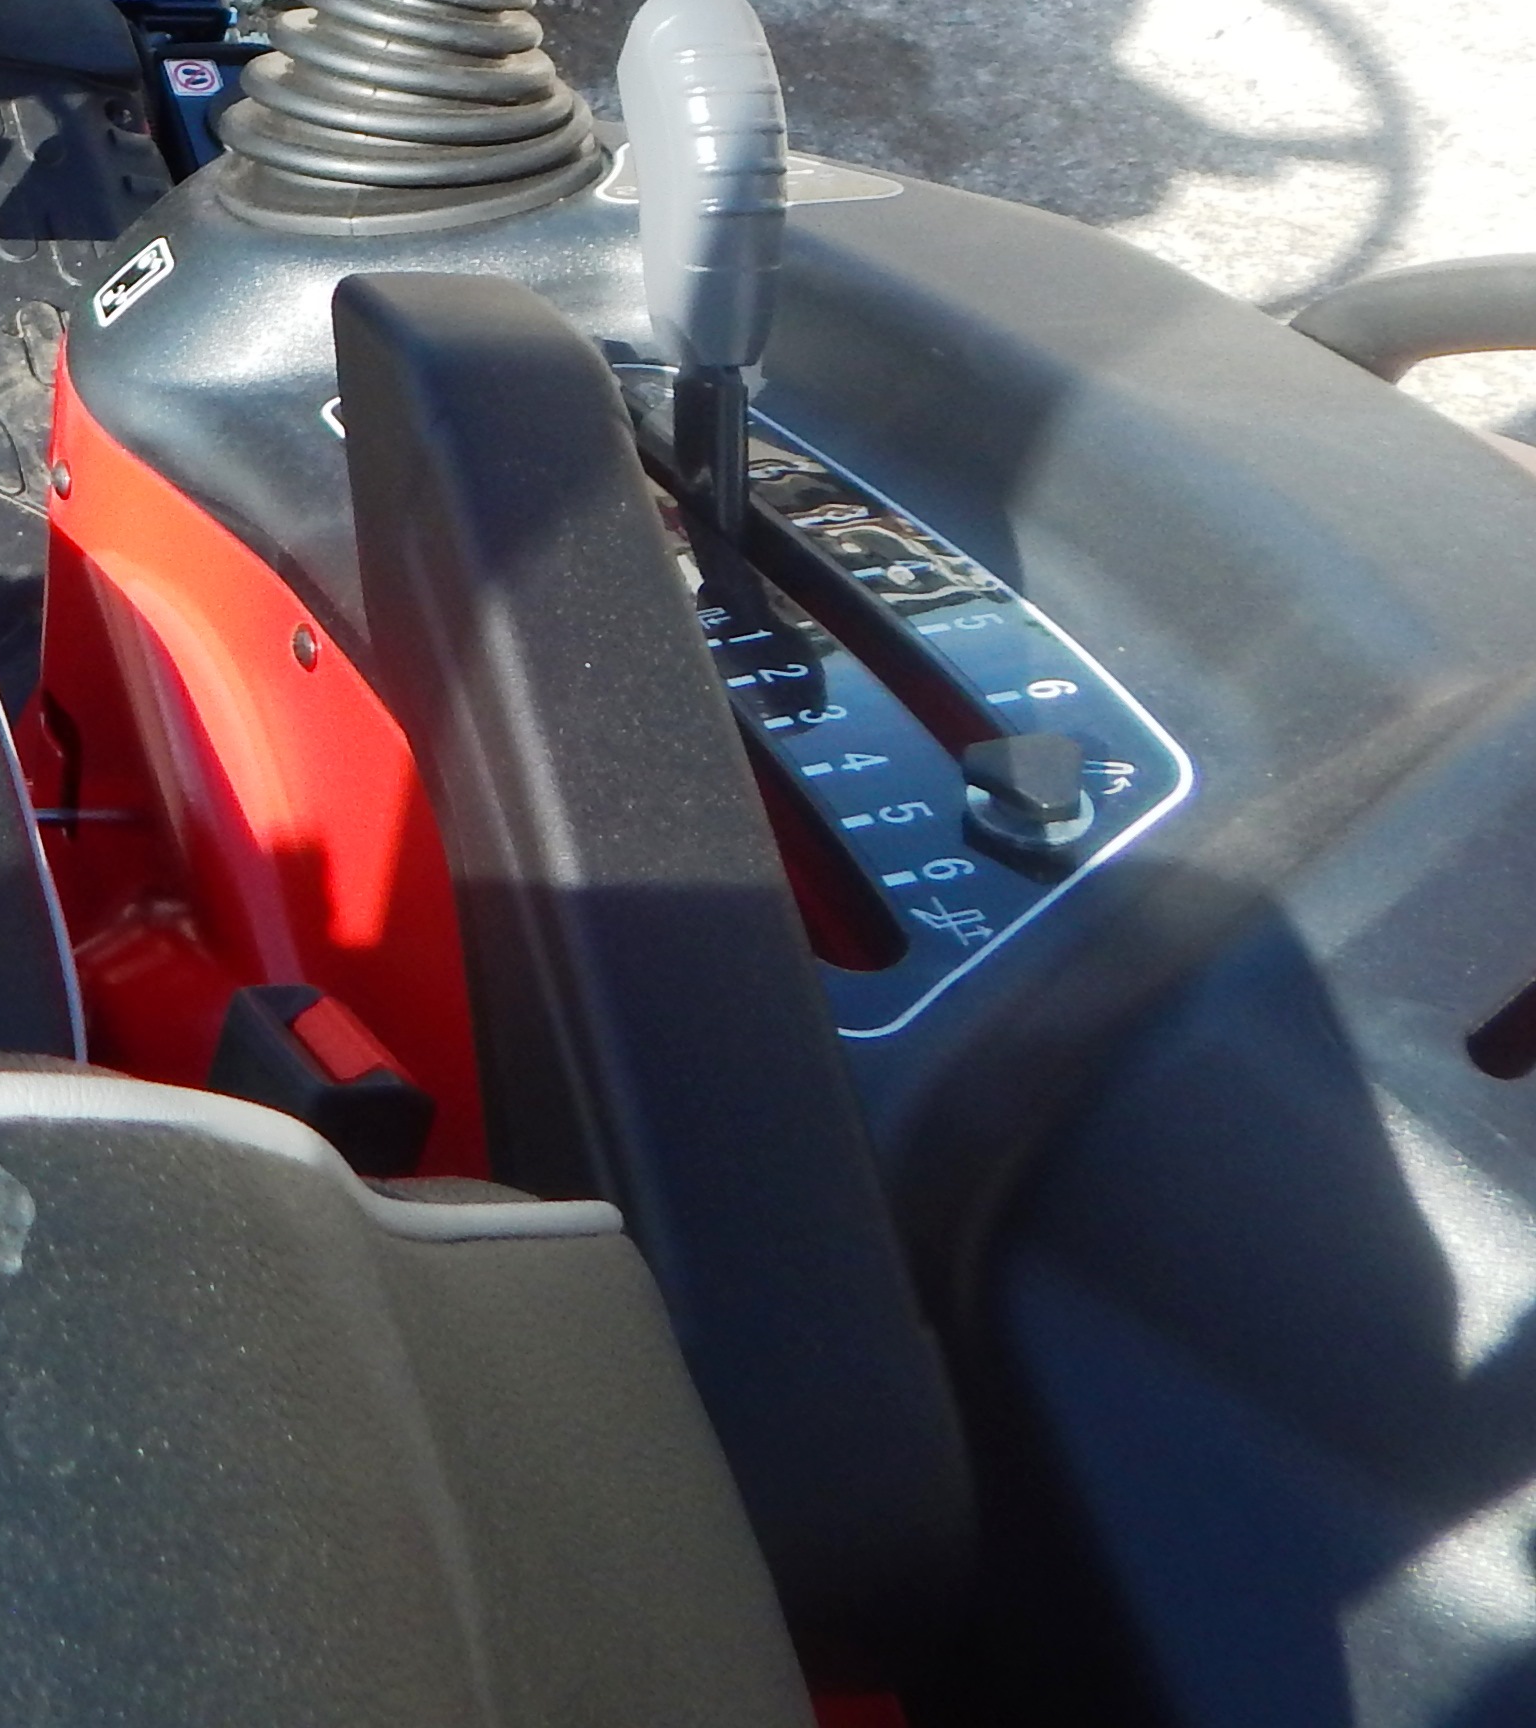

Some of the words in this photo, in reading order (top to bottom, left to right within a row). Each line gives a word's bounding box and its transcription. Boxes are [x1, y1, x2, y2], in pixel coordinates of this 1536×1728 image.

[953, 613, 1005, 633] 5
[758, 663, 810, 686] 2
[1028, 678, 1078, 701] 6
[799, 703, 848, 726] 3
[837, 750, 891, 776] 4
[878, 801, 935, 825] 5
[921, 856, 978, 883] 6
